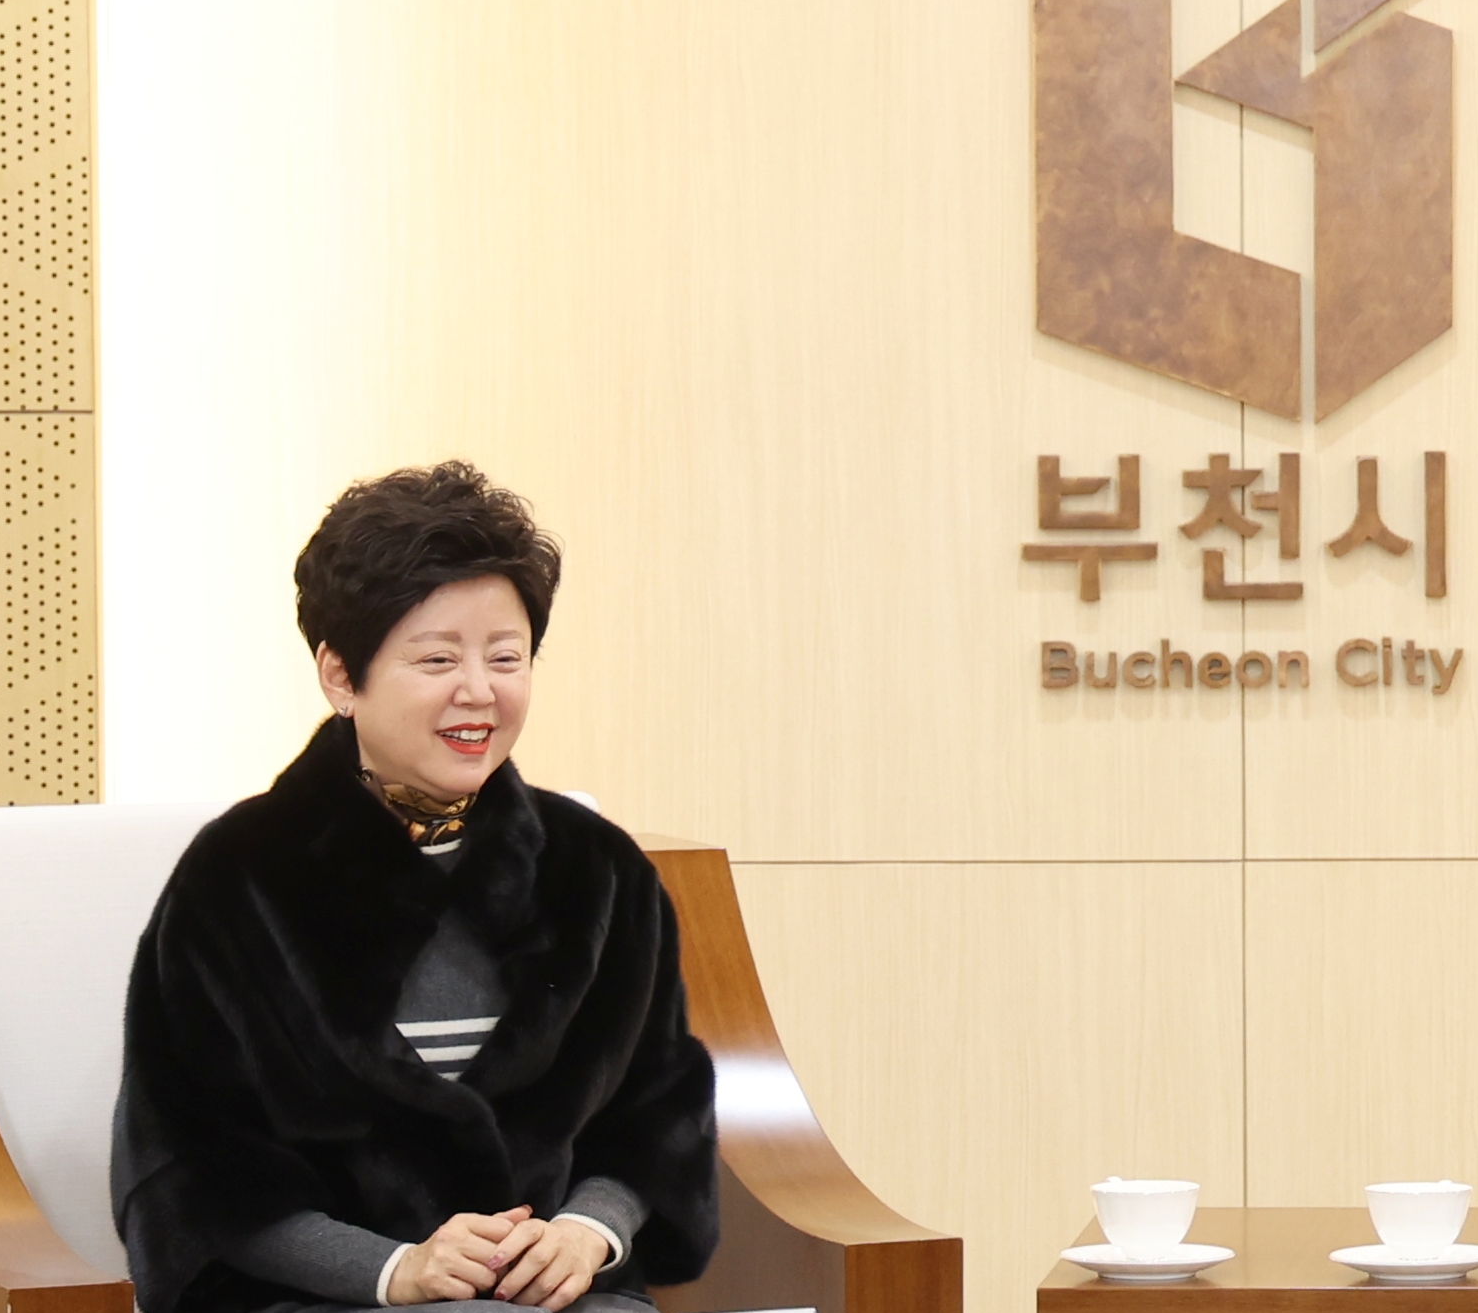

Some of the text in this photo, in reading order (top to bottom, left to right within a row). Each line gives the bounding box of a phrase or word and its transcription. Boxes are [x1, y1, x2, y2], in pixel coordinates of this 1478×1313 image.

[1021, 451, 1448, 602] 부천시
[1040, 636, 1464, 695] Bucheon City
